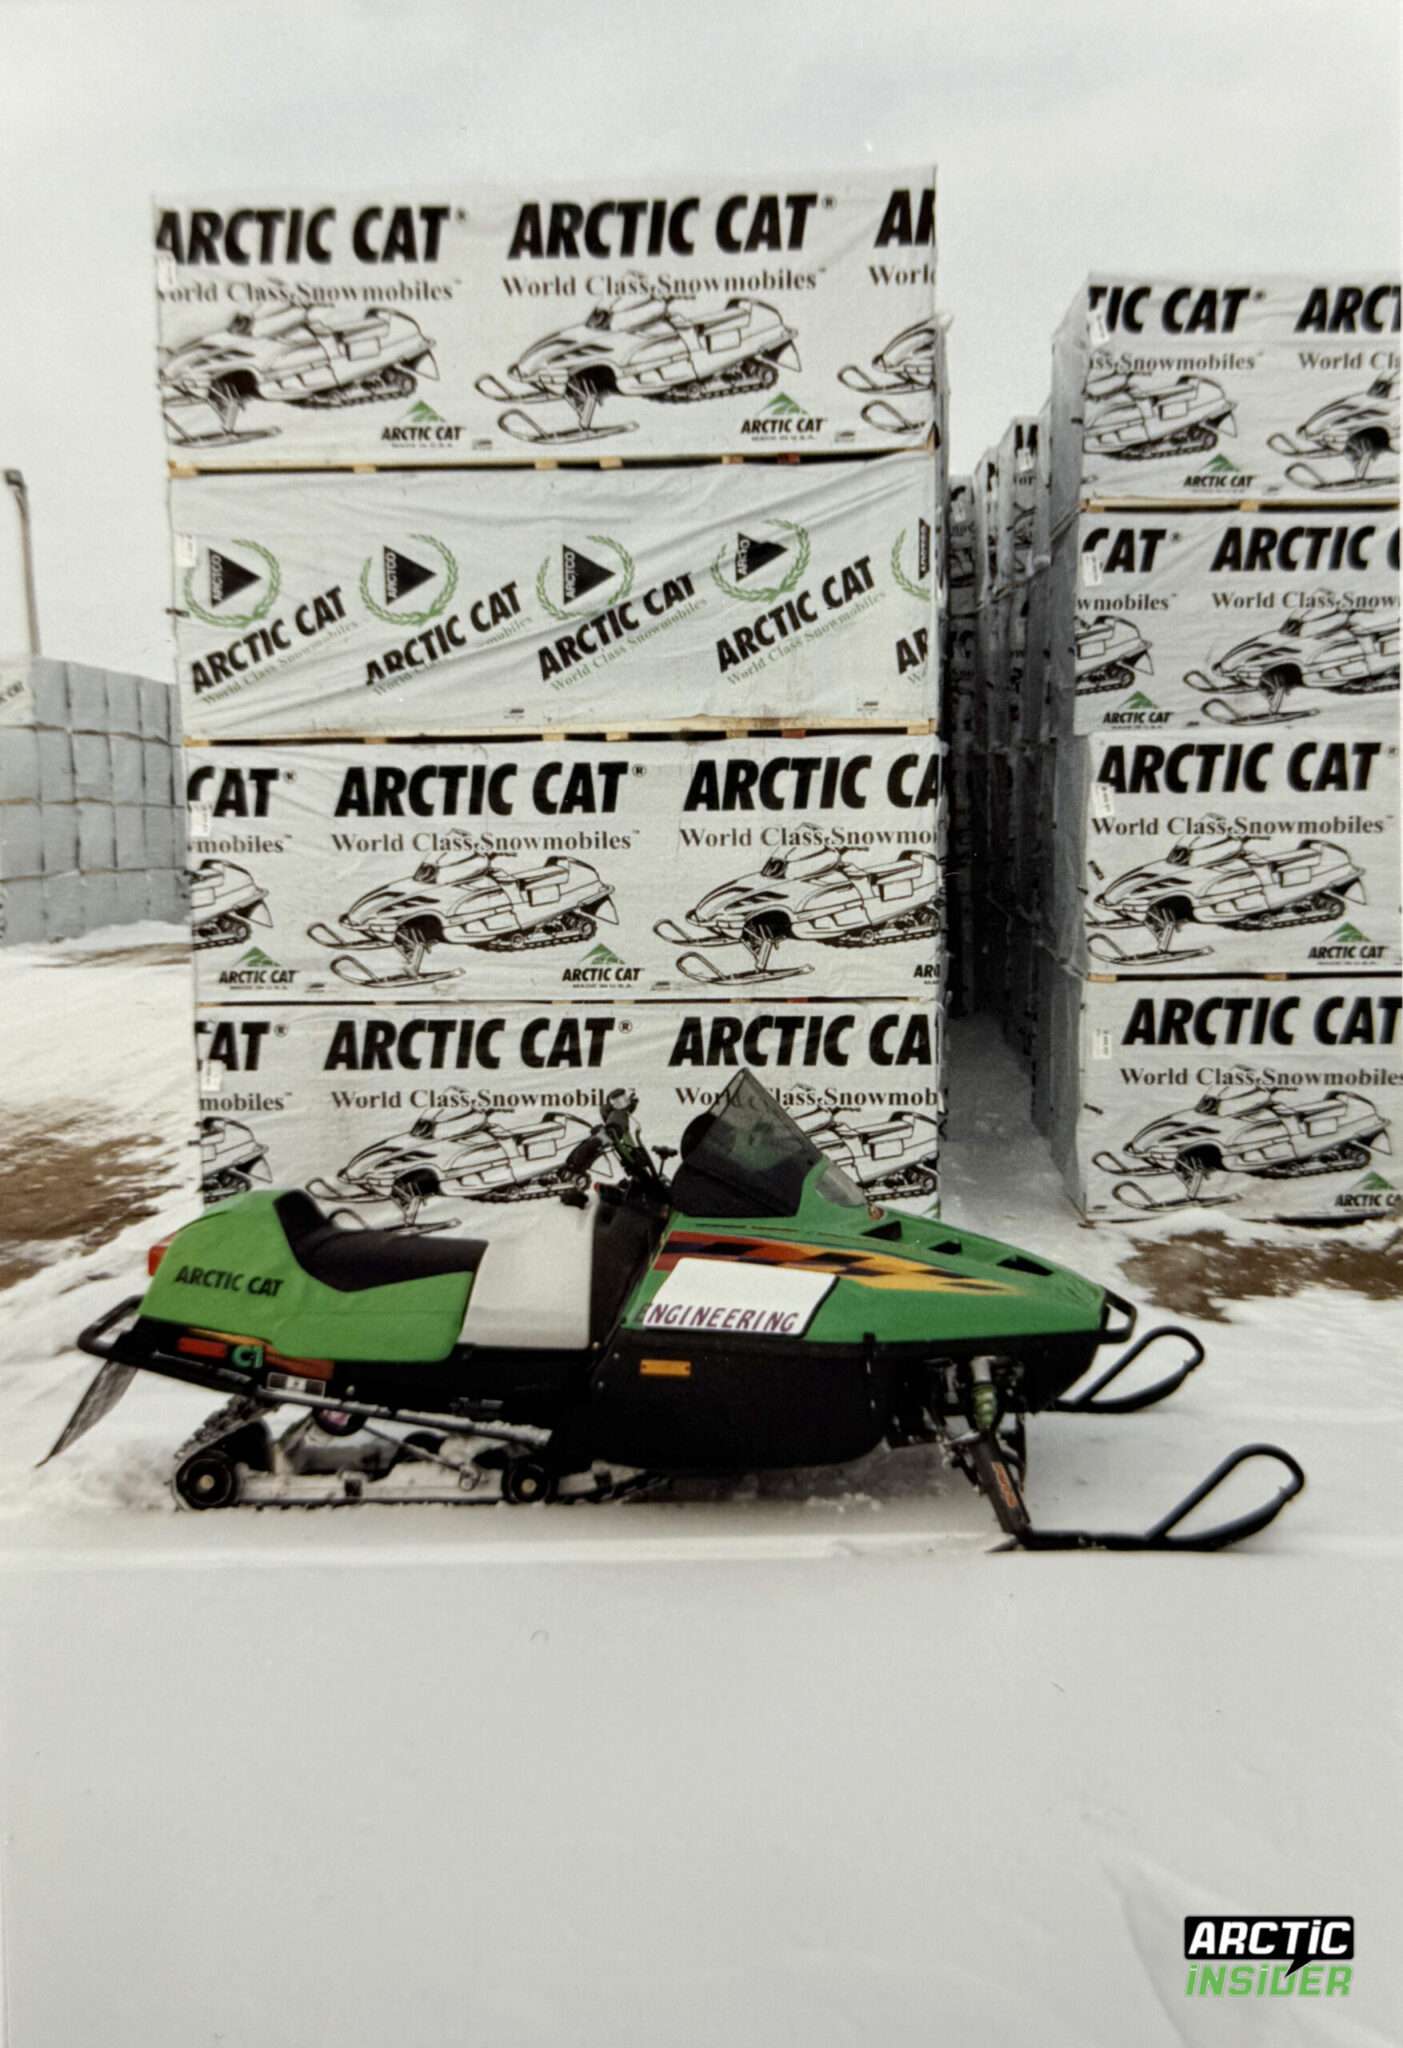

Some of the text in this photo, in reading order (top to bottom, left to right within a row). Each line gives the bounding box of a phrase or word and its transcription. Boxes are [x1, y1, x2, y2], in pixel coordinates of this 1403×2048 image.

[156, 207, 337, 265] ARCTIC
[508, 198, 700, 260] ARCTIC
[502, 276, 577, 298] World
[586, 274, 650, 297] Class
[1299, 351, 1363, 370] World
[381, 426, 462, 440] ARCTIC CAT
[740, 418, 824, 434] ARCTIC CAT
[1183, 475, 1228, 488] ARCTIC
[1209, 526, 1376, 573] ARCTIC
[1211, 591, 1275, 609] World
[538, 571, 696, 682] ARCTIC CAT
[716, 555, 875, 674] ARCTIC CAT
[191, 586, 347, 694] ARCTIC CAT
[366, 580, 522, 686] ARCTIC CAT
[551, 665, 592, 692] World
[726, 658, 767, 686] World
[1103, 711, 1145, 724] ARCTIC
[1097, 742, 1274, 794] ARCTIC
[334, 762, 518, 817] ARCTIC
[683, 755, 872, 812] ARCTIC
[680, 828, 752, 848] World
[760, 826, 823, 847] Class
[1091, 817, 1159, 836] World
[1167, 816, 1226, 836] Class
[331, 833, 404, 852] World
[412, 832, 474, 852] Class
[1307, 945, 1357, 959] ARCTIC
[218, 969, 296, 984] ARCTIC CAT
[561, 967, 641, 982] ARCTIC CAT
[1122, 996, 1300, 1046] ARCTIC
[1314, 996, 1402, 1046] CAT
[323, 1018, 506, 1072] ARCTIC
[668, 1014, 933, 1067] ARCTIC CA
[1120, 1067, 1188, 1087] World
[1195, 1066, 1255, 1086] Class
[331, 1090, 401, 1110] World
[409, 1089, 471, 1109] Class
[175, 1265, 285, 1298] ARCTIC CAT
